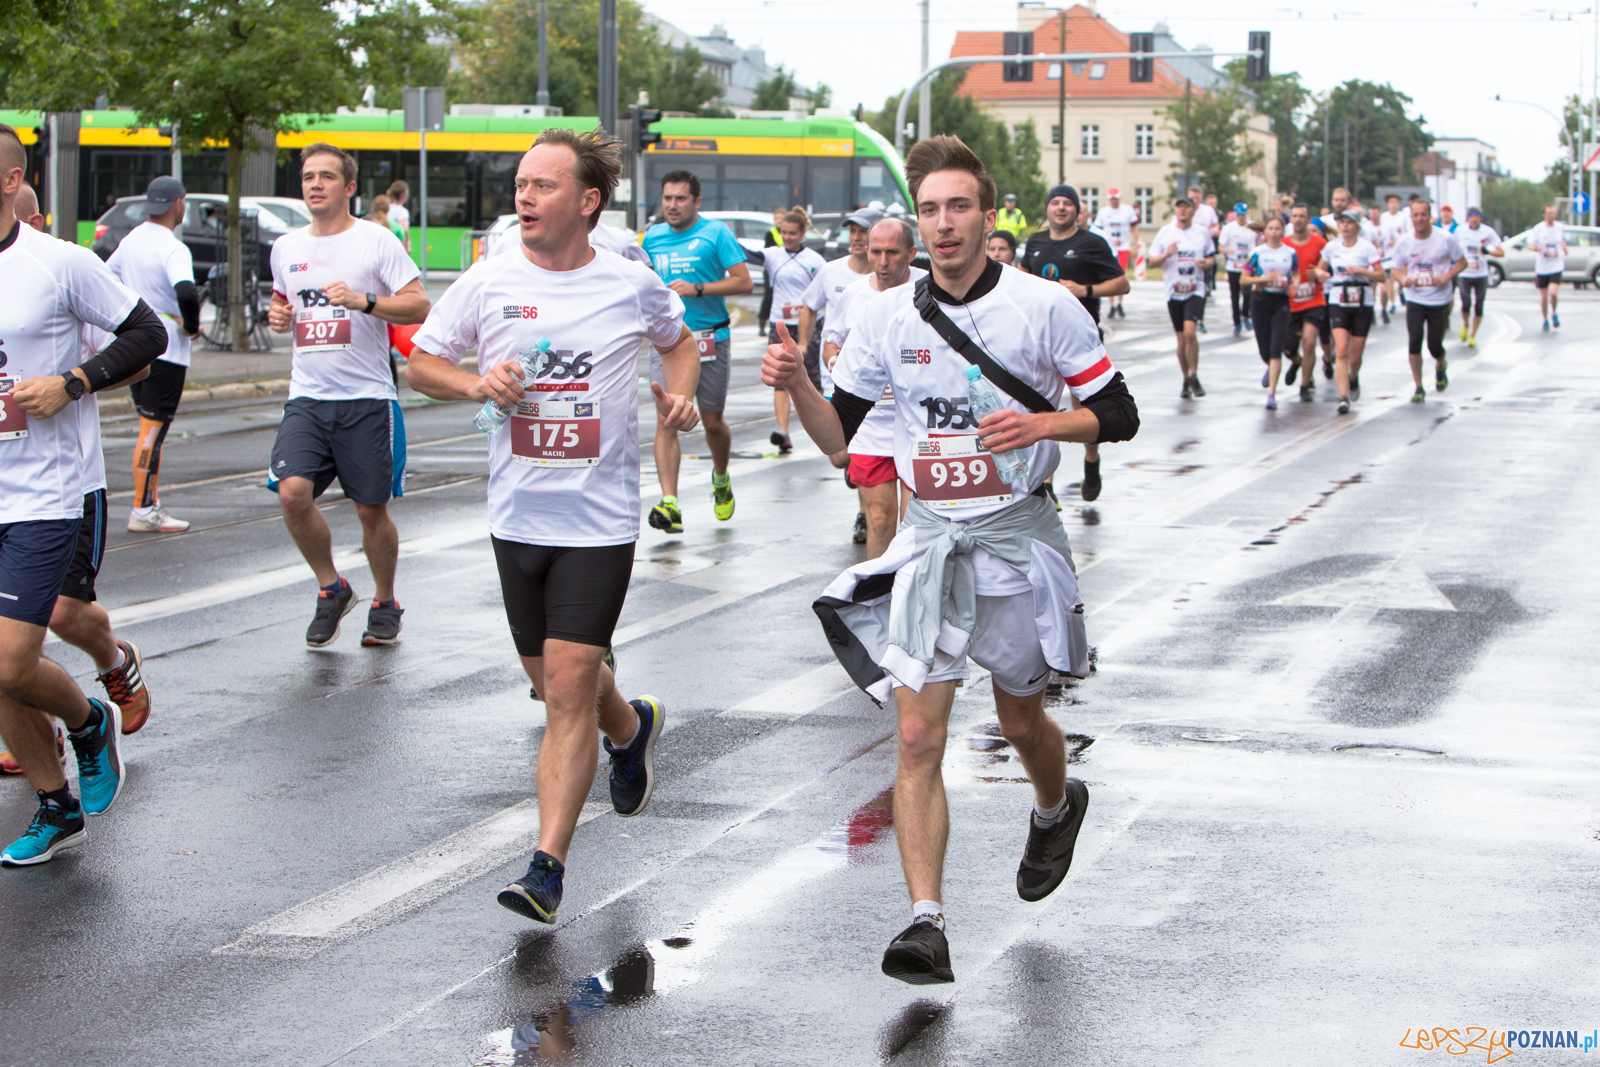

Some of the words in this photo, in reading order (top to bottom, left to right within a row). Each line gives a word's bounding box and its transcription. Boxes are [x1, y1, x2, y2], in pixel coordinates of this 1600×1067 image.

[305, 321, 339, 339] 207
[528, 423, 580, 448] 175
[542, 450, 565, 458] MACIEJ
[930, 459, 988, 488] 939
